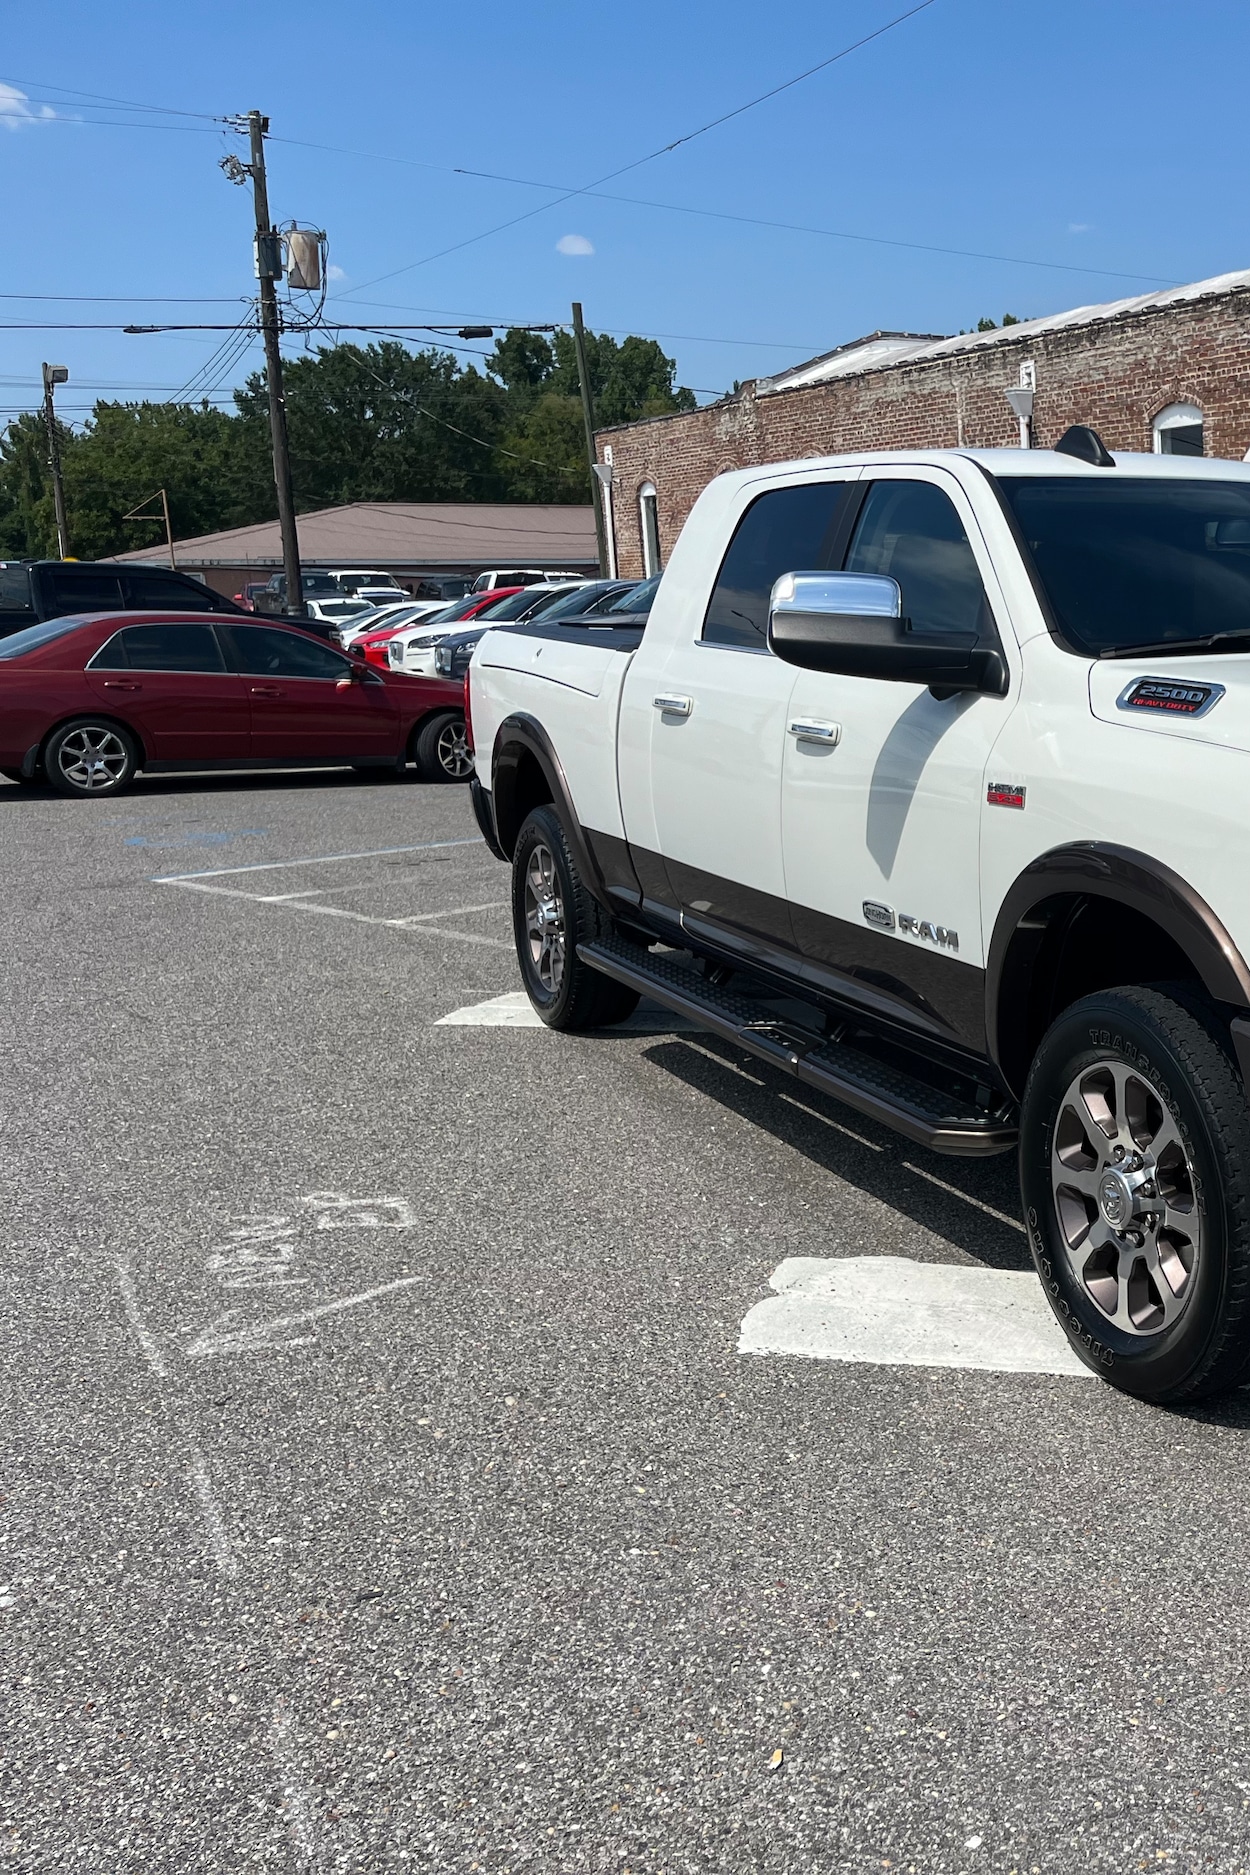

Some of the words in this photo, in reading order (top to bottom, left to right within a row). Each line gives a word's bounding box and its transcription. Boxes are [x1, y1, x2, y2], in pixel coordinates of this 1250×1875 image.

[1139, 685, 1204, 702] 2500
[1132, 698, 1167, 709] HEAVY
[1167, 702, 1196, 712] DUTY
[988, 782, 1027, 796] HEMI
[898, 912, 960, 949] RAM
